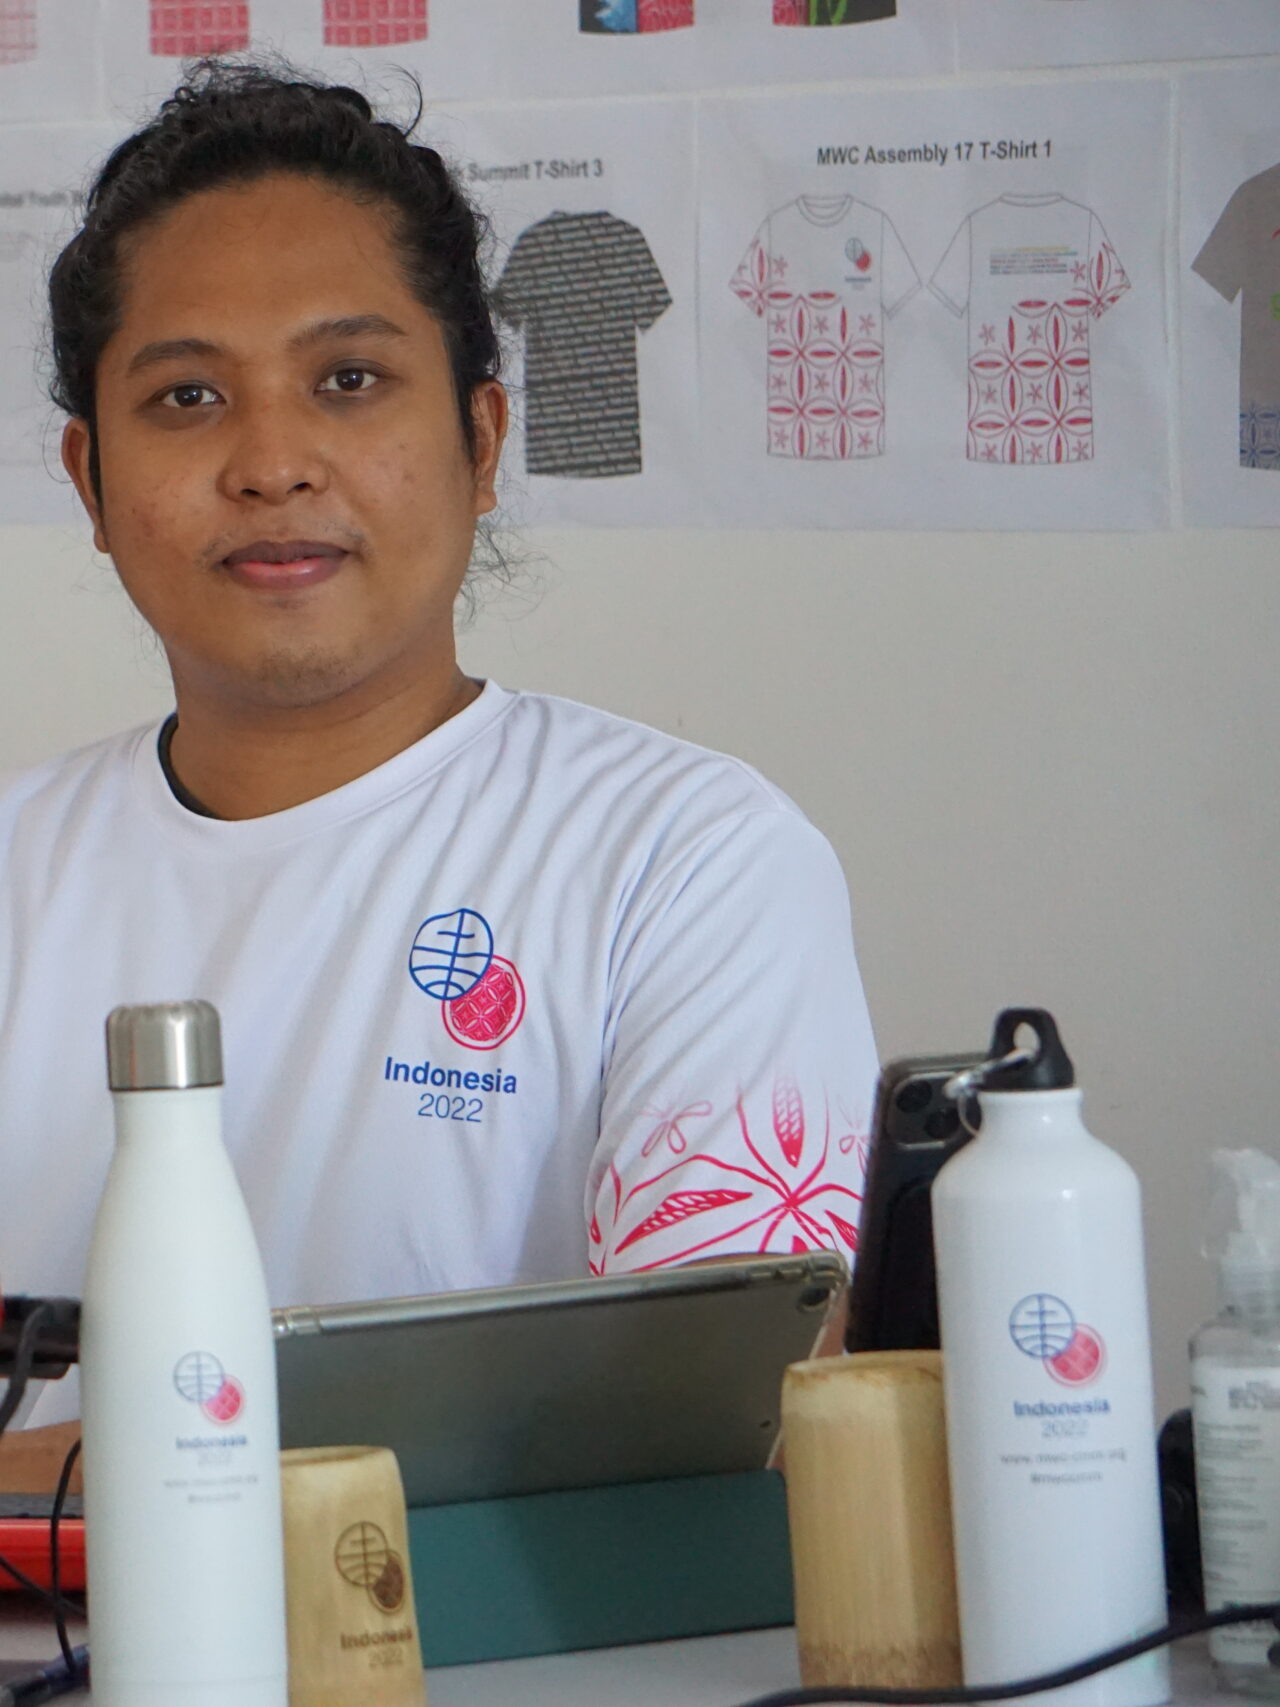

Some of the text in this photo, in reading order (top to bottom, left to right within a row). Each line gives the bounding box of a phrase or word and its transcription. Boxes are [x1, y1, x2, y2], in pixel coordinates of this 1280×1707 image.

[817, 139, 1052, 166] MWC Assembly 17 T-Shirt 1
[469, 162, 529, 181] Summit
[534, 160, 588, 179] T-Shirt
[593, 158, 603, 177] 3
[385, 1056, 517, 1094] Indonesia
[418, 1093, 483, 1123] 2022
[1013, 1400, 1110, 1417] Indonesia
